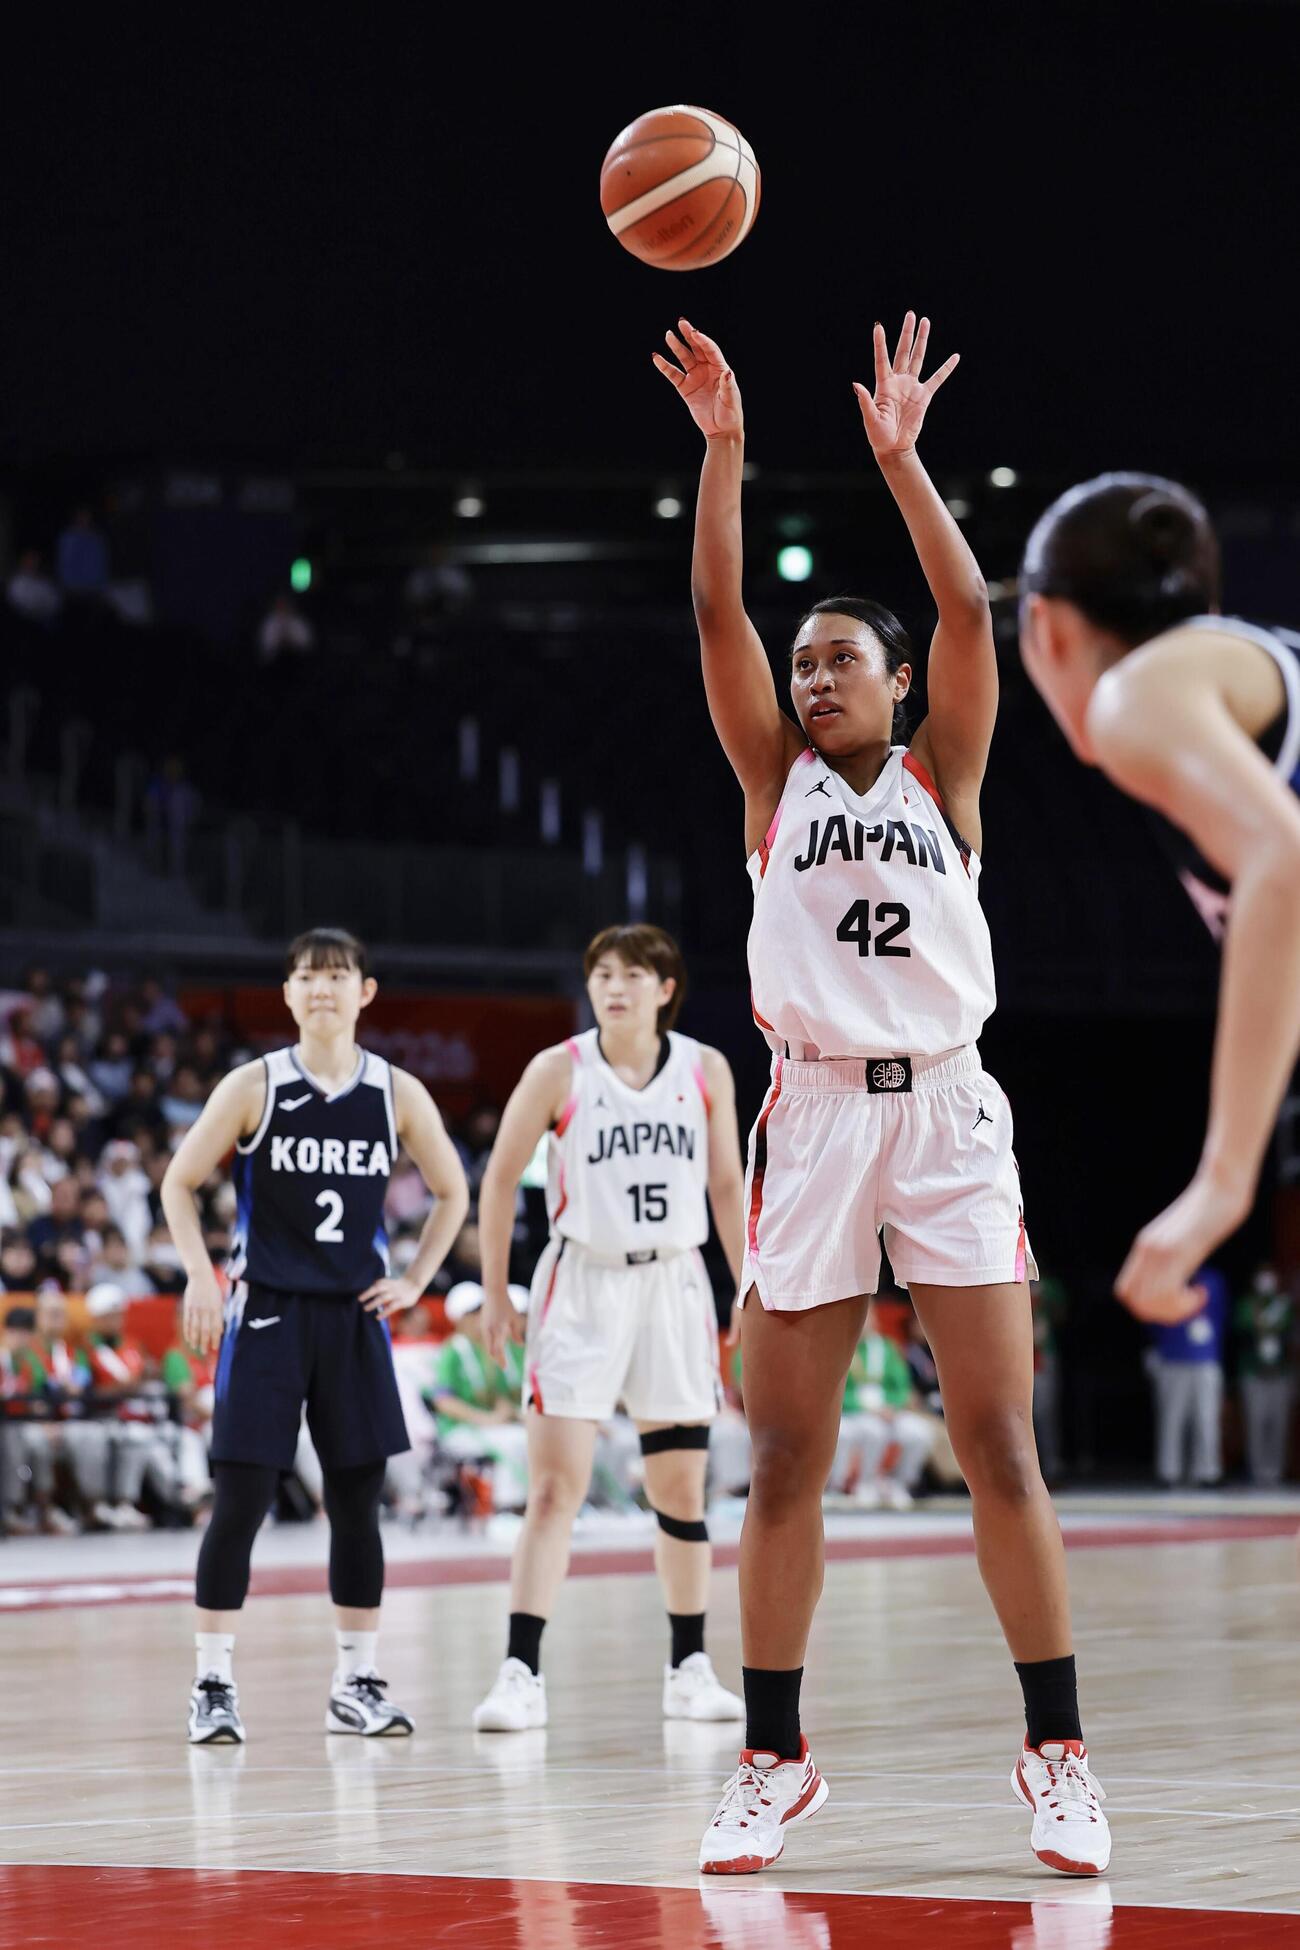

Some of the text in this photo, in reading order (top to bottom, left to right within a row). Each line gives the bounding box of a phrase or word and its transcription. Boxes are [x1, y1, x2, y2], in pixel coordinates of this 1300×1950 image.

[794, 815, 947, 876] JAPAN
[836, 899, 911, 957] 42
[270, 1136, 390, 1177] KOREA
[587, 1122, 695, 1164] JAPAN
[314, 1189, 345, 1243] 2
[626, 1183, 668, 1223] 15
